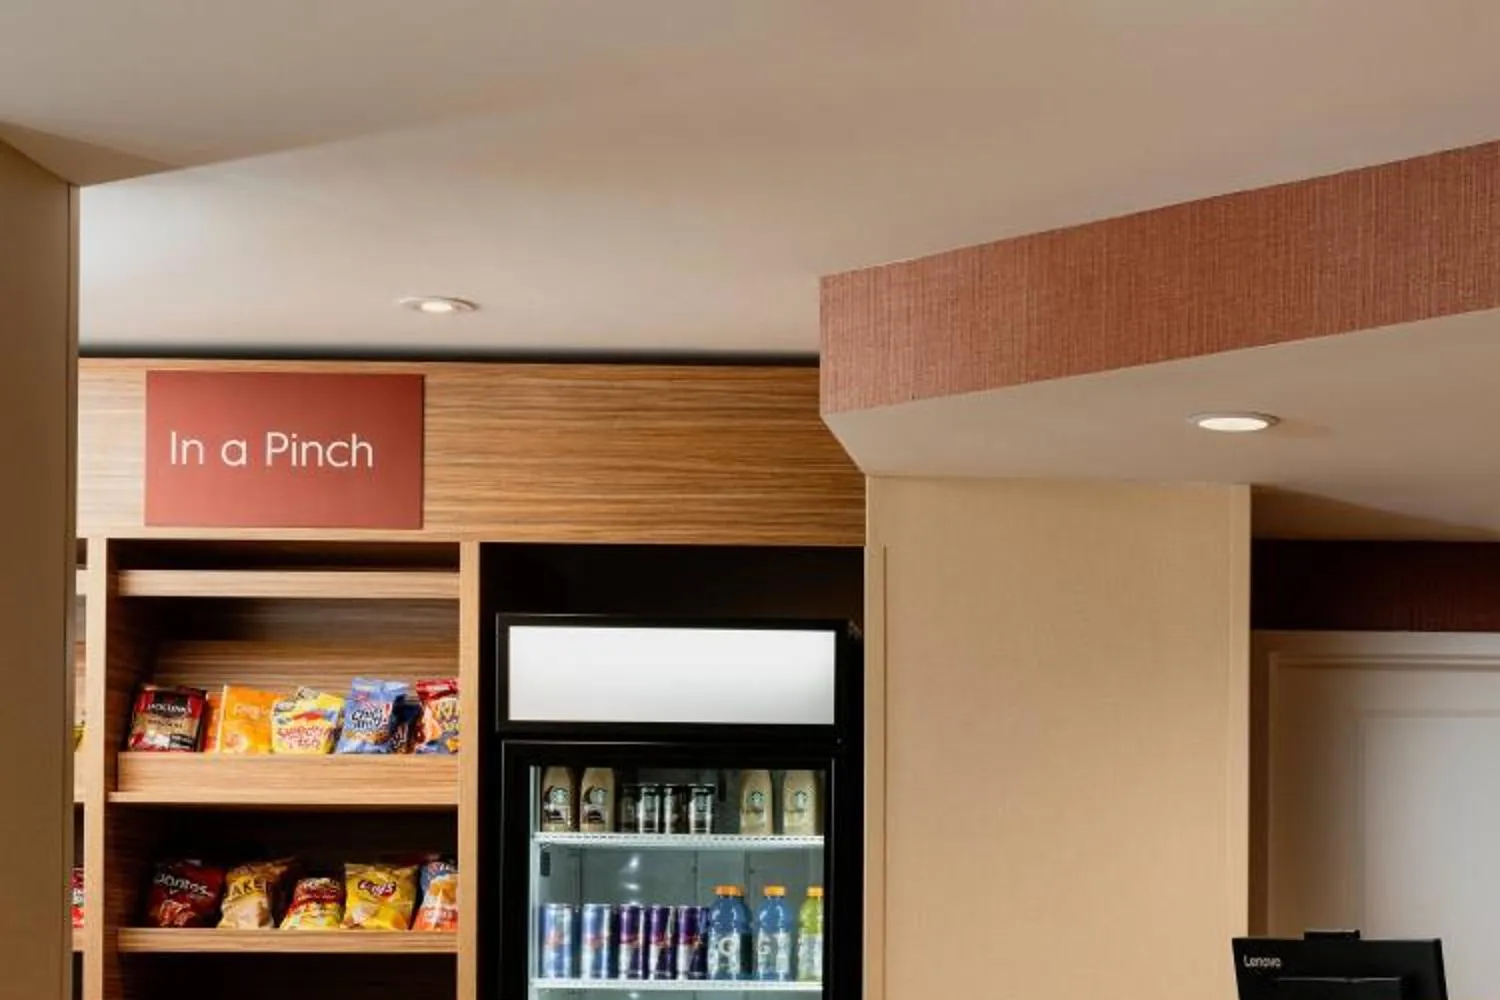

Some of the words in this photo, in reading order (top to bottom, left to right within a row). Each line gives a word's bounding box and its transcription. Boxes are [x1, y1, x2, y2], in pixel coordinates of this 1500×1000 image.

[169, 431, 205, 466] In
[220, 439, 248, 467] a
[265, 431, 374, 468] Pinch
[1243, 954, 1282, 969] Lenovo
